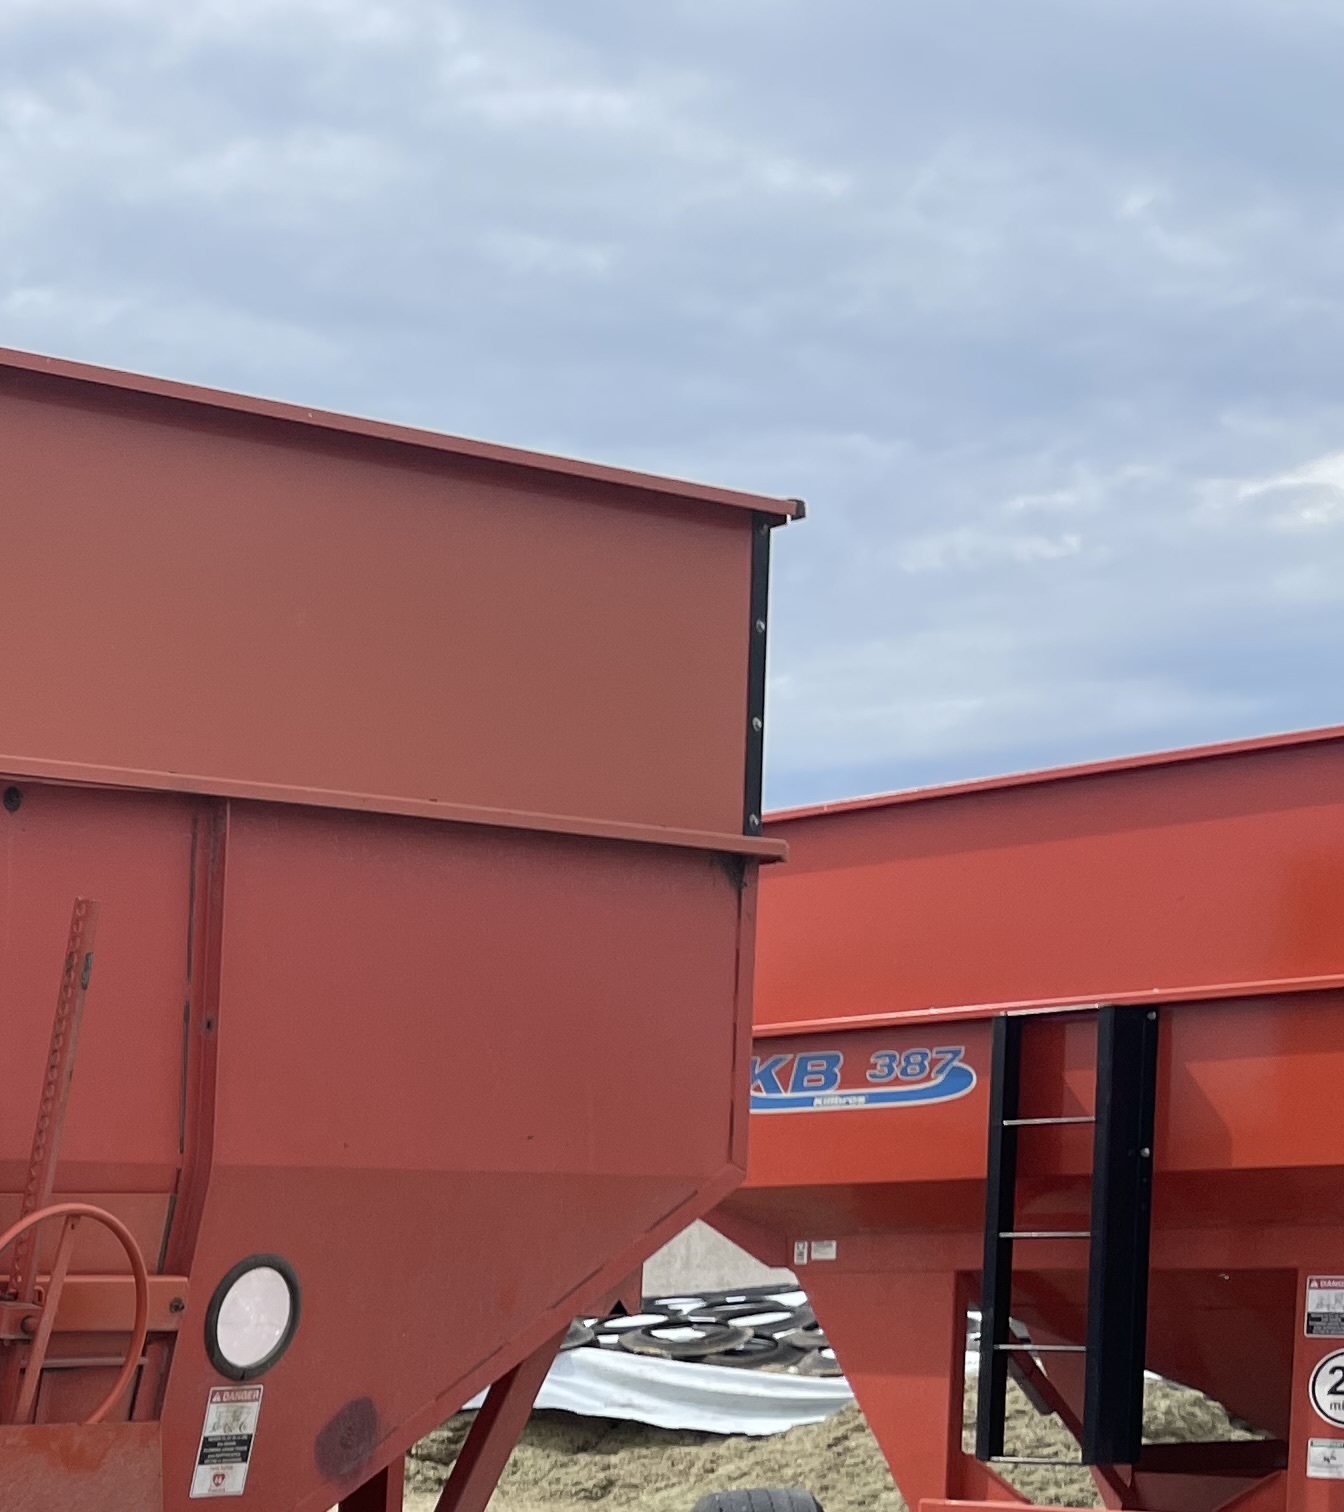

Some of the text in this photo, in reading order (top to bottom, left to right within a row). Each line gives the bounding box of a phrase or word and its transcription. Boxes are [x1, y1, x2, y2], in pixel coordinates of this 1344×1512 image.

[751, 1046, 965, 1096] KB 387
[223, 1390, 259, 1402] DANGER
